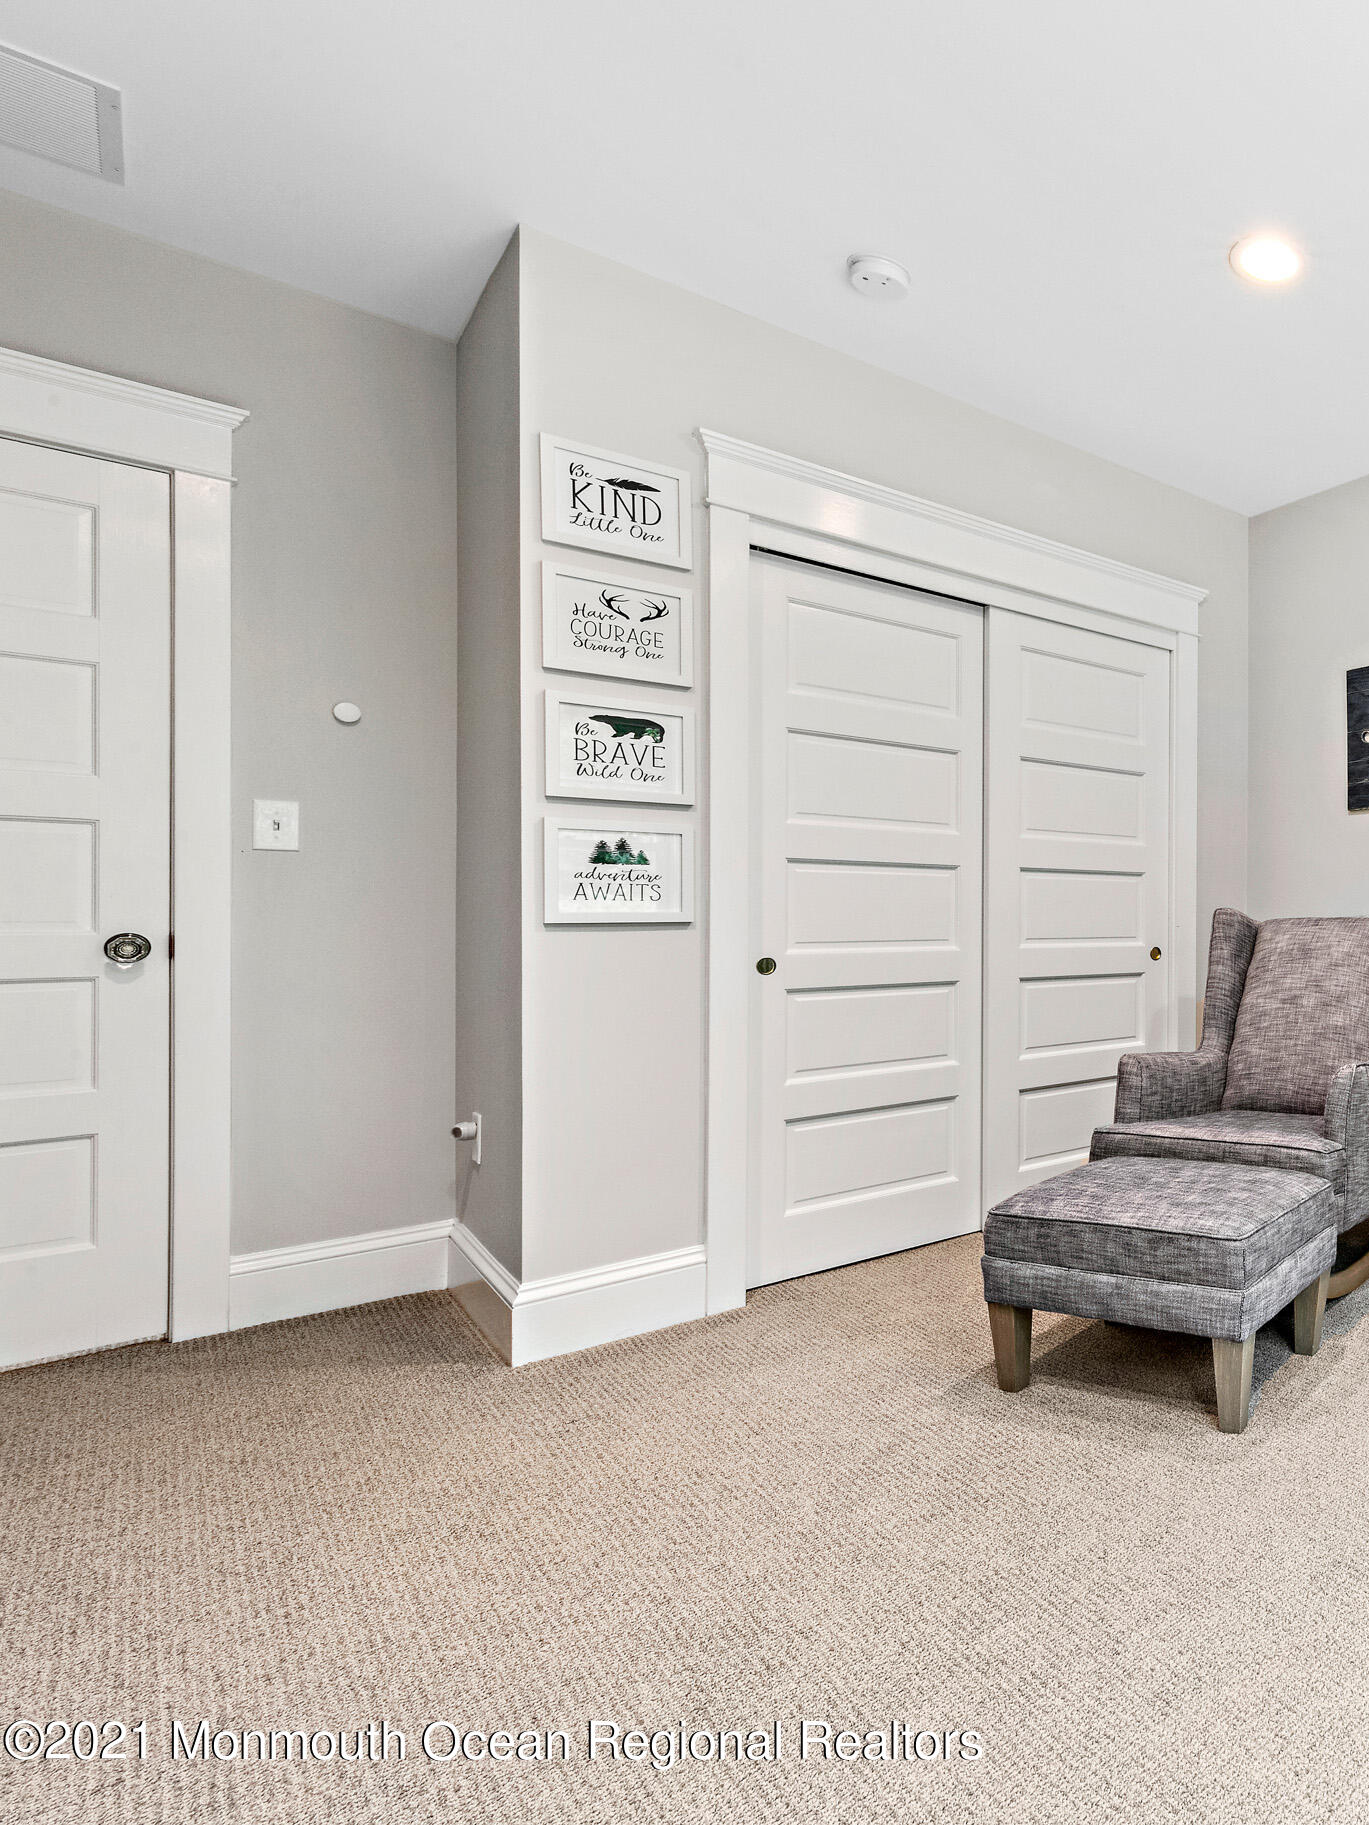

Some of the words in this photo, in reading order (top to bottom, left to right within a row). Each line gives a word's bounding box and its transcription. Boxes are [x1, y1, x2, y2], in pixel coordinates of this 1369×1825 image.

[569, 462, 593, 479] Be
[570, 478, 662, 526] KIND
[569, 512, 622, 534] Little
[629, 524, 665, 543] One
[572, 602, 617, 621] Have
[570, 618, 664, 649] COURAGE
[573, 635, 629, 659] Strong
[635, 645, 664, 660] One
[574, 721, 599, 737] Be
[573, 737, 666, 769] BRAVE
[576, 762, 624, 779] Wild
[630, 766, 665, 783] One
[573, 866, 662, 882] adventure
[572, 882, 662, 902] AWAITS
